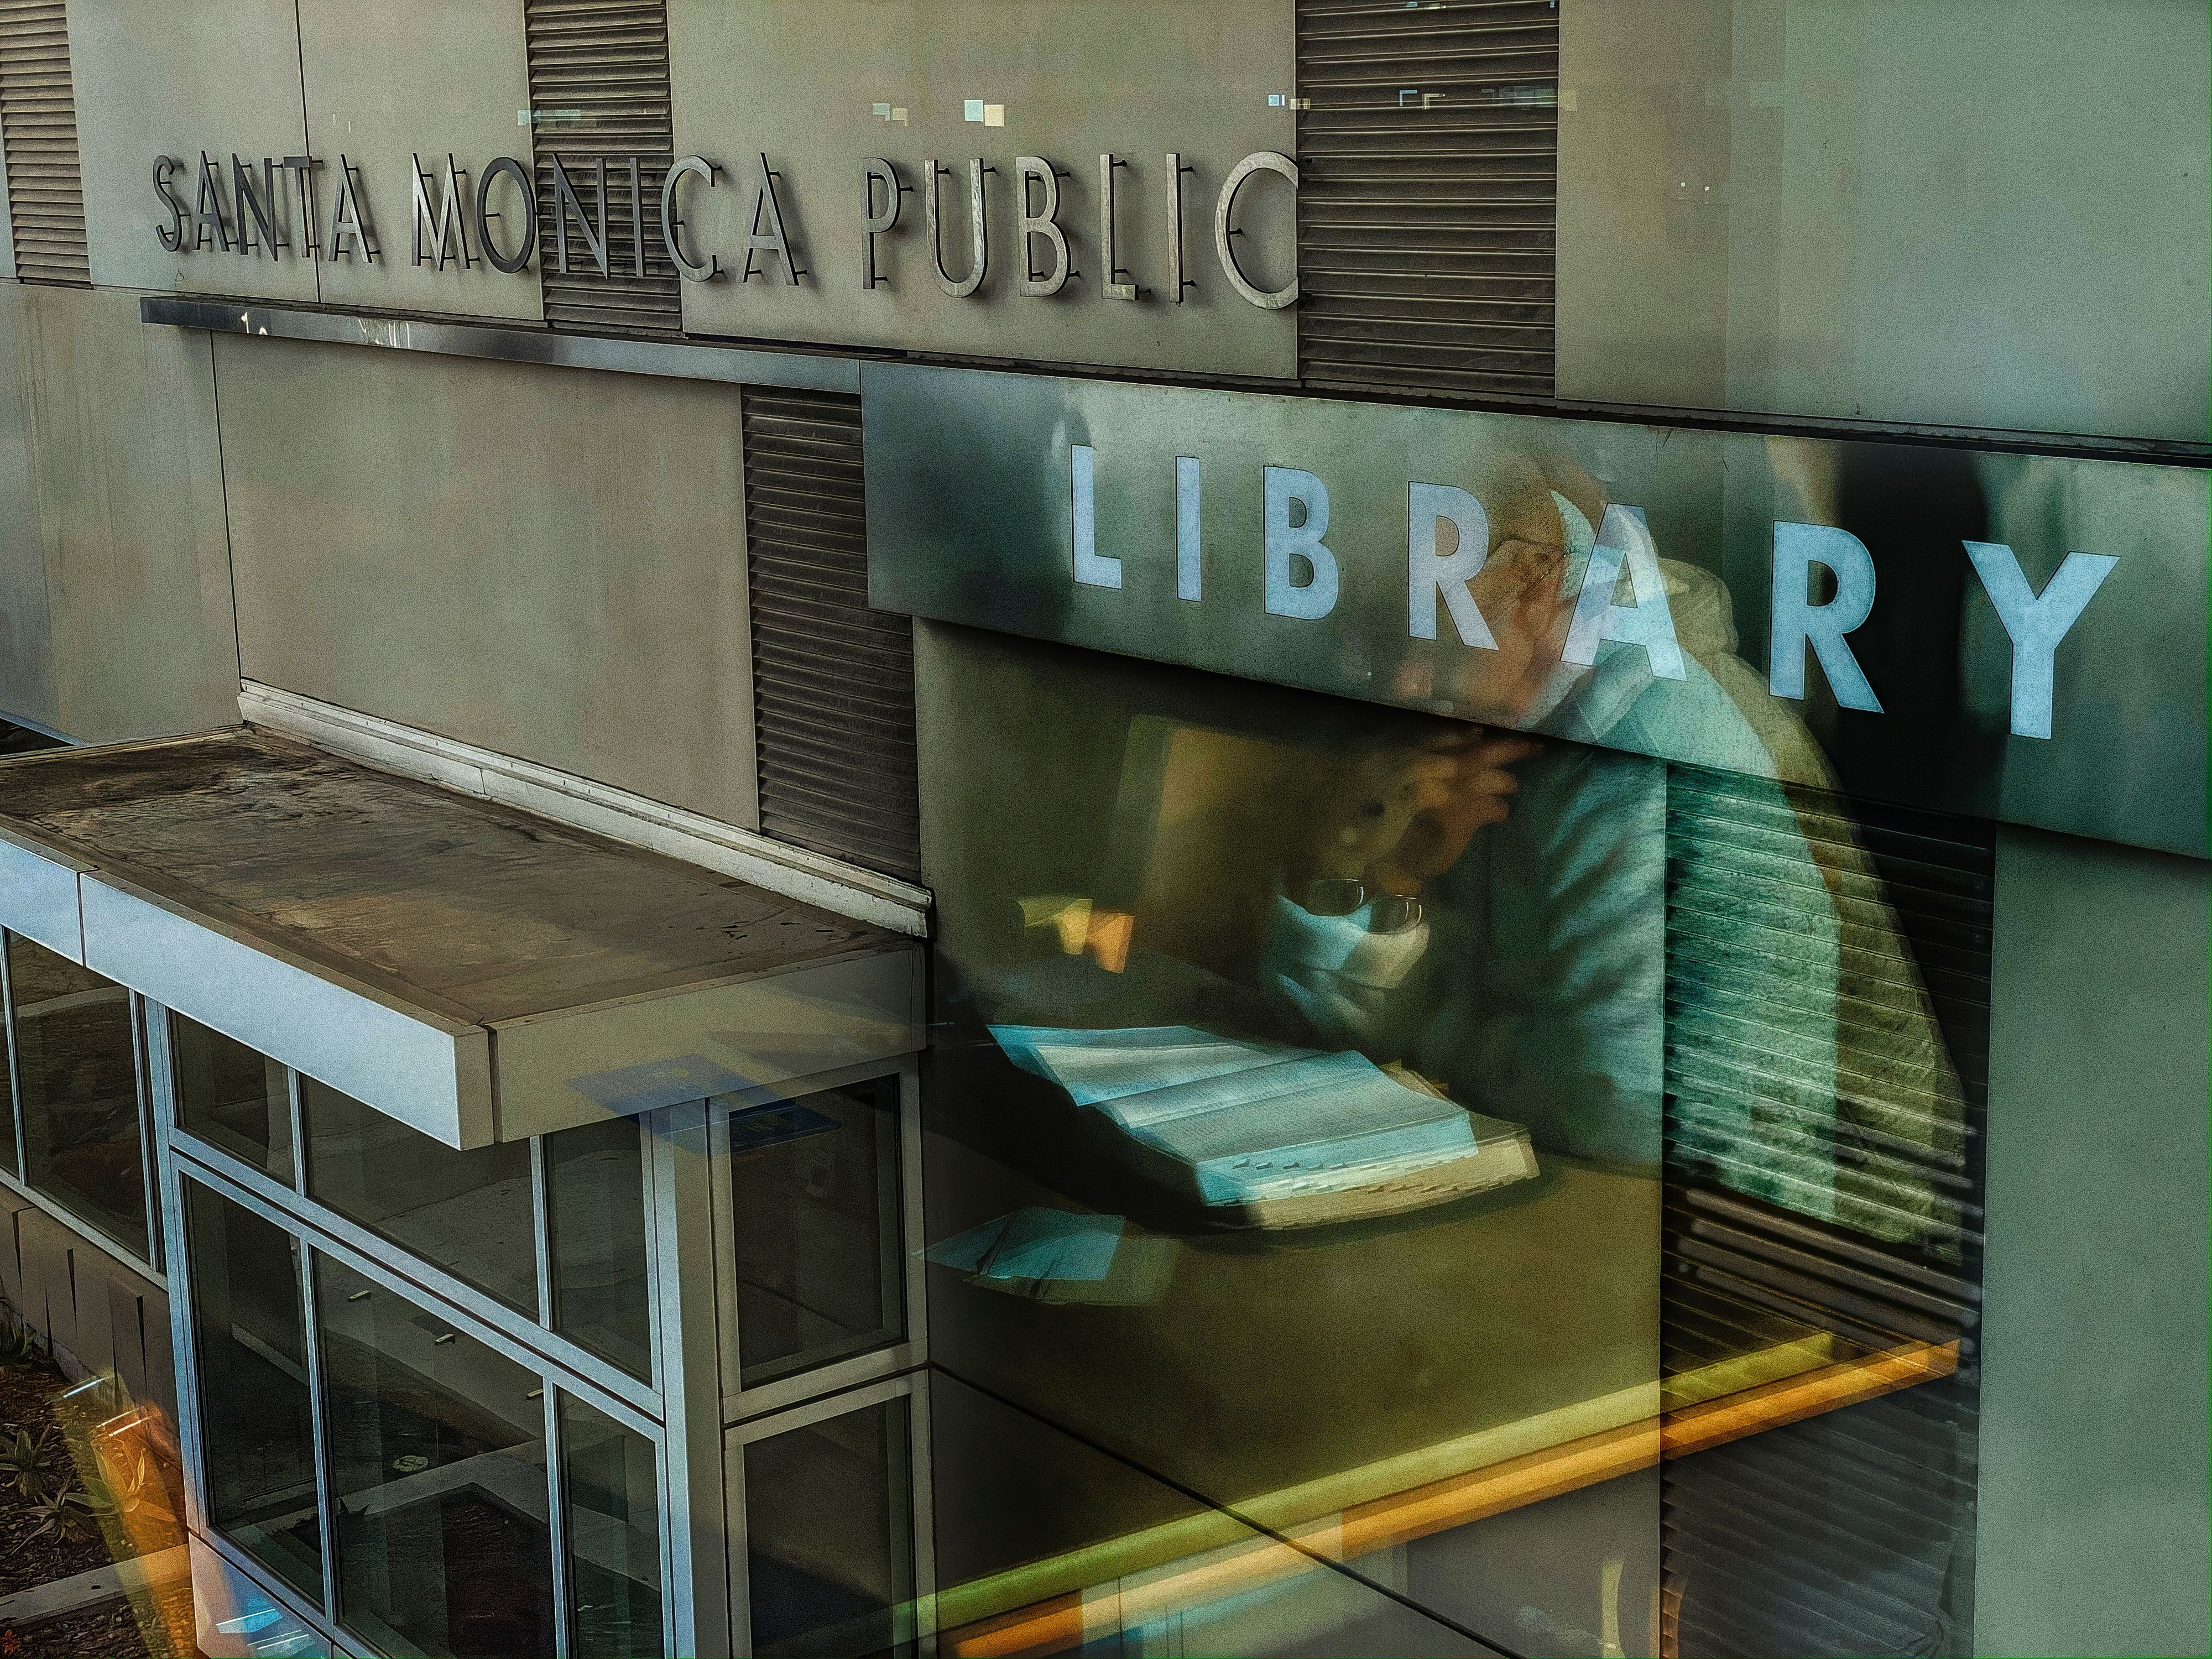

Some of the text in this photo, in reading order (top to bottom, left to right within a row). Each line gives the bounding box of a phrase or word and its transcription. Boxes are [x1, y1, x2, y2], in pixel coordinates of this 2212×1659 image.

[153, 150, 1299, 309] SANTA MONICA PUBLIC
[1071, 445, 2120, 740] LIBRARY
